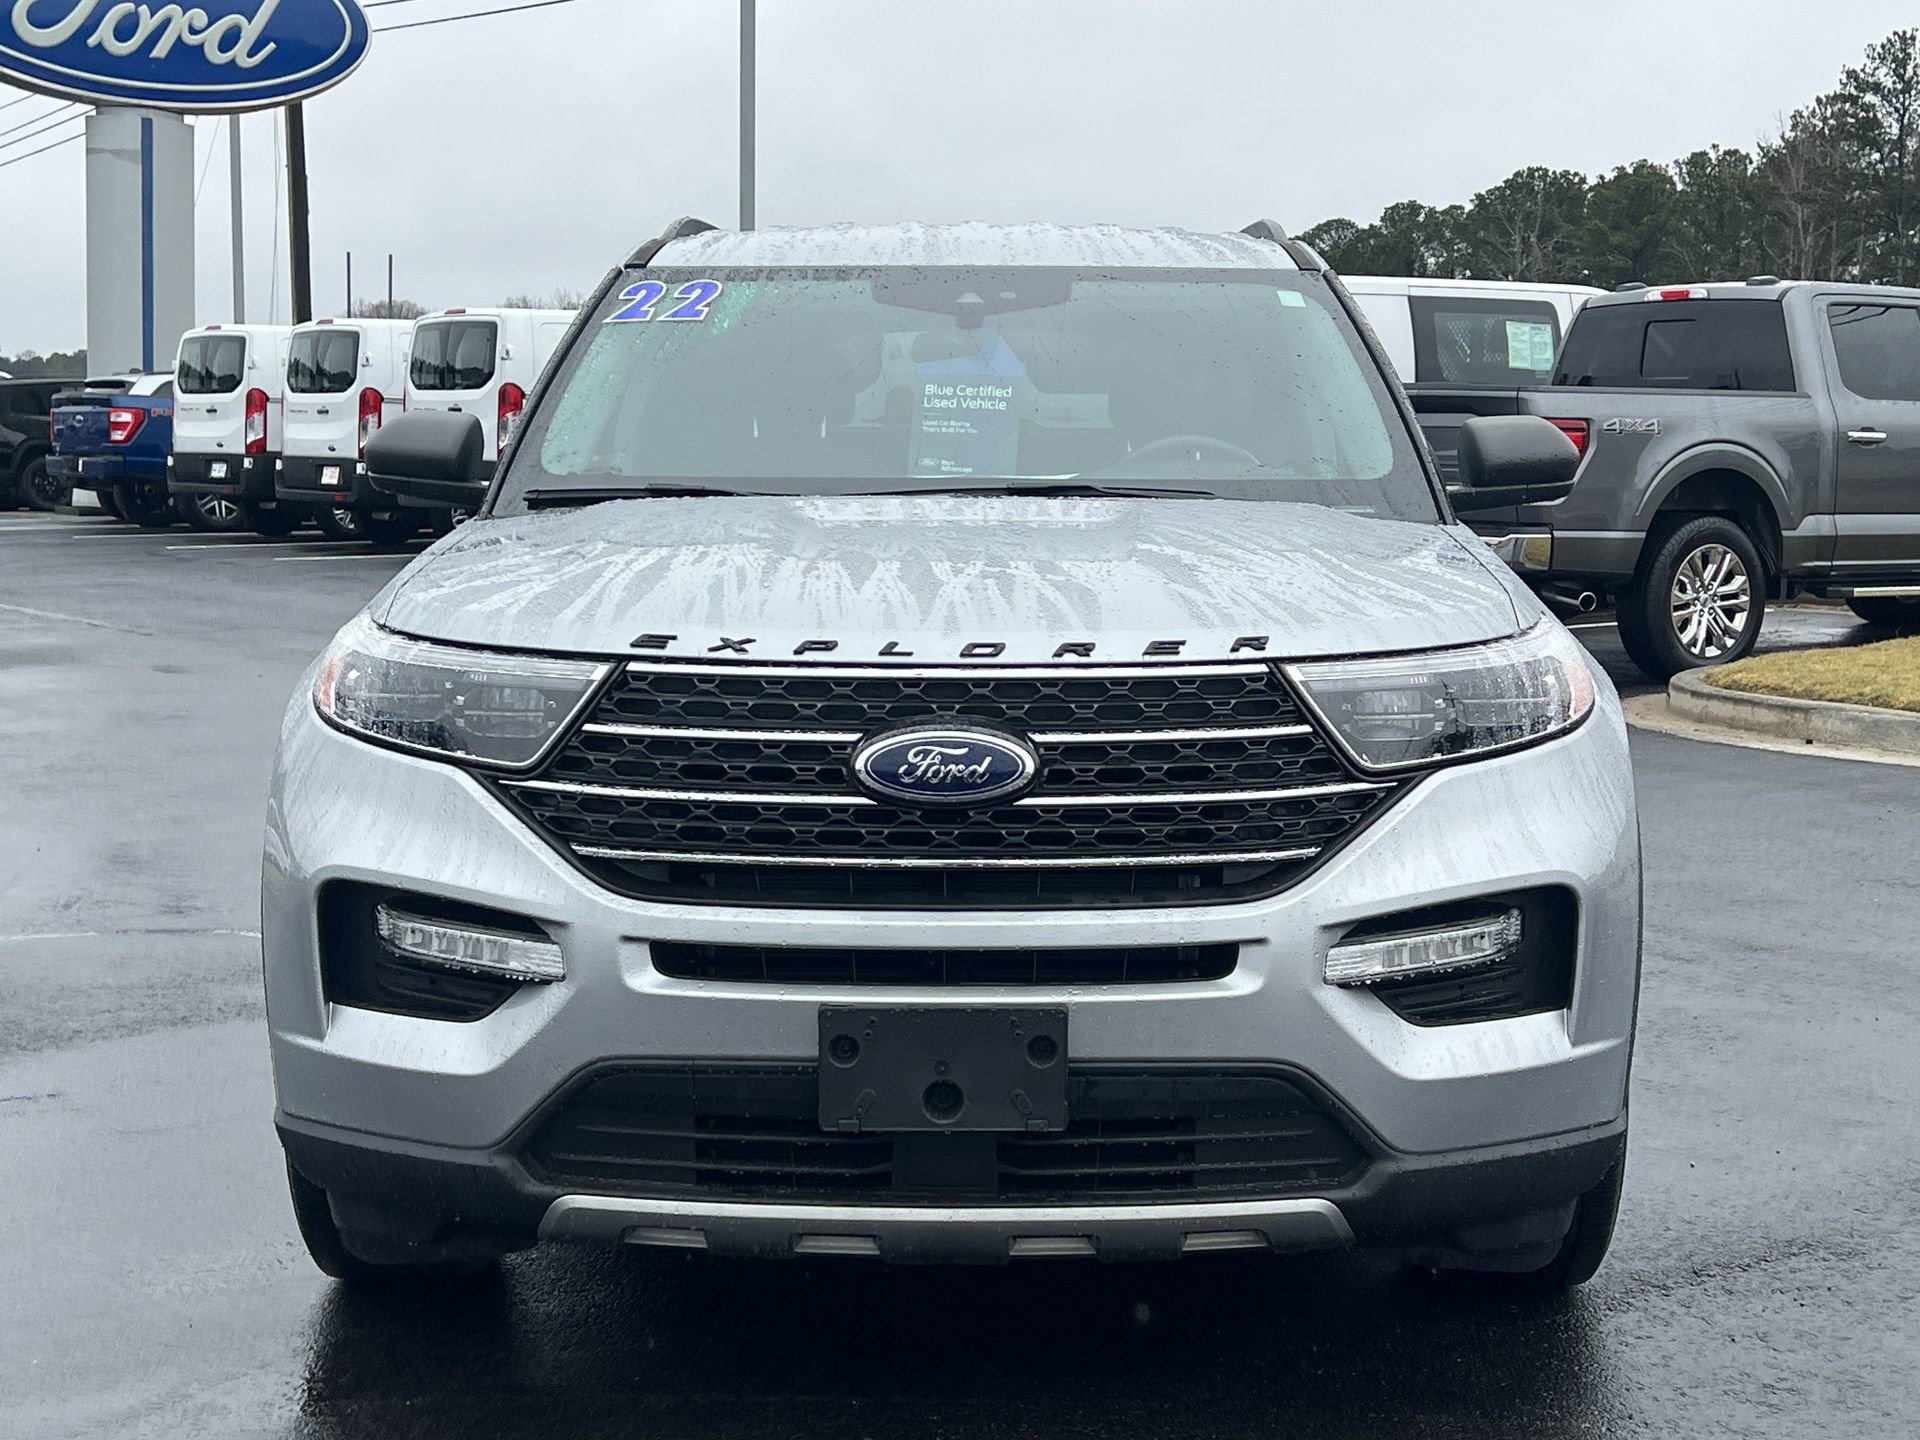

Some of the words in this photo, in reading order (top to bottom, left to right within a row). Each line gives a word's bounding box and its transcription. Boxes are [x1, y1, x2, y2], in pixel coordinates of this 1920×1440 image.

[602, 279, 723, 323] 22
[924, 384, 954, 396] Blue
[956, 385, 1012, 398] Certified
[922, 396, 958, 409] Used
[960, 397, 1007, 411] Vehicle
[630, 633, 1269, 657] EXPLORER
[898, 745, 992, 784] Ford
